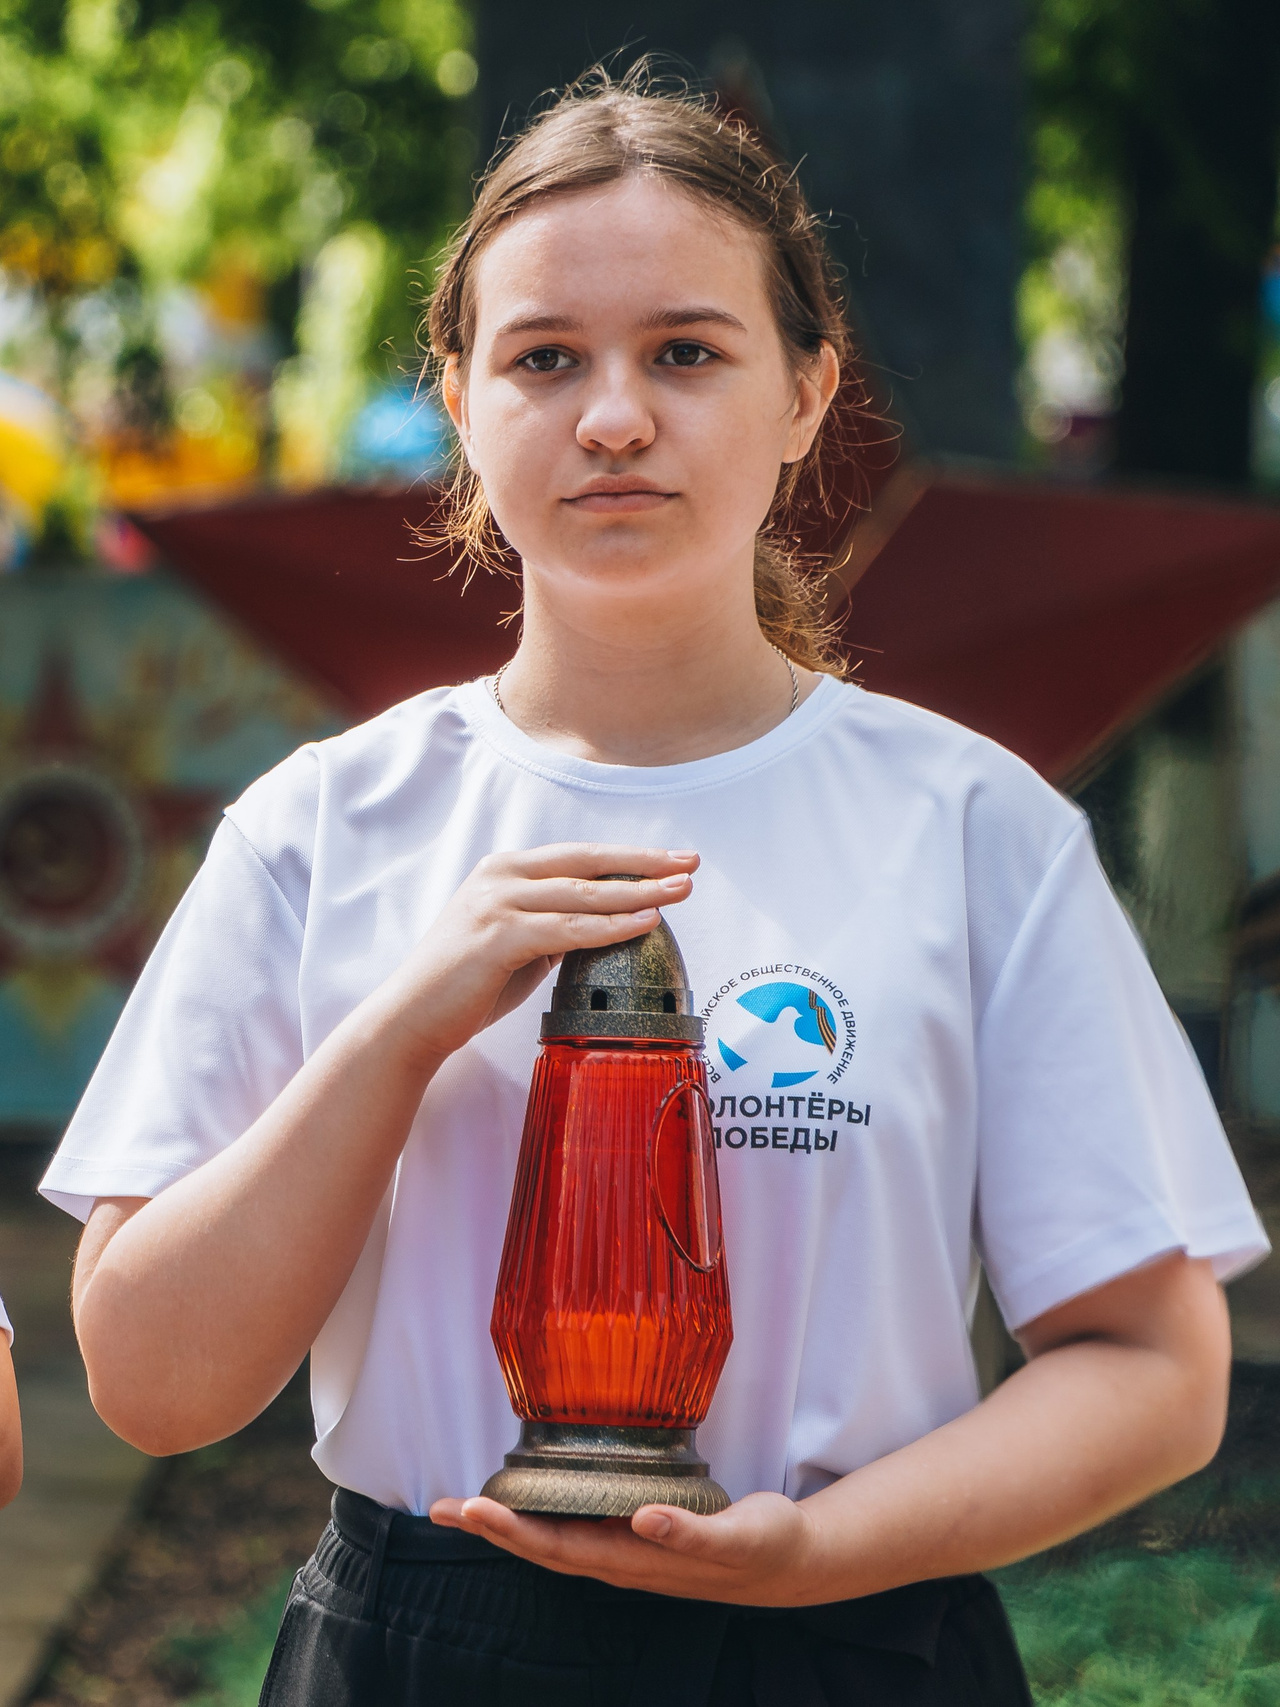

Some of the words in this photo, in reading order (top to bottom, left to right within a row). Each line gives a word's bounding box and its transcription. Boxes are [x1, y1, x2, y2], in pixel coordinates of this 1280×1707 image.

[740, 963, 850, 1009] ОБЩЕСТВЕННОЕ
[826, 1010, 858, 1085] ДВИЖЕНИЕ
[709, 1091, 872, 1127] ЛОНТЁРЫ
